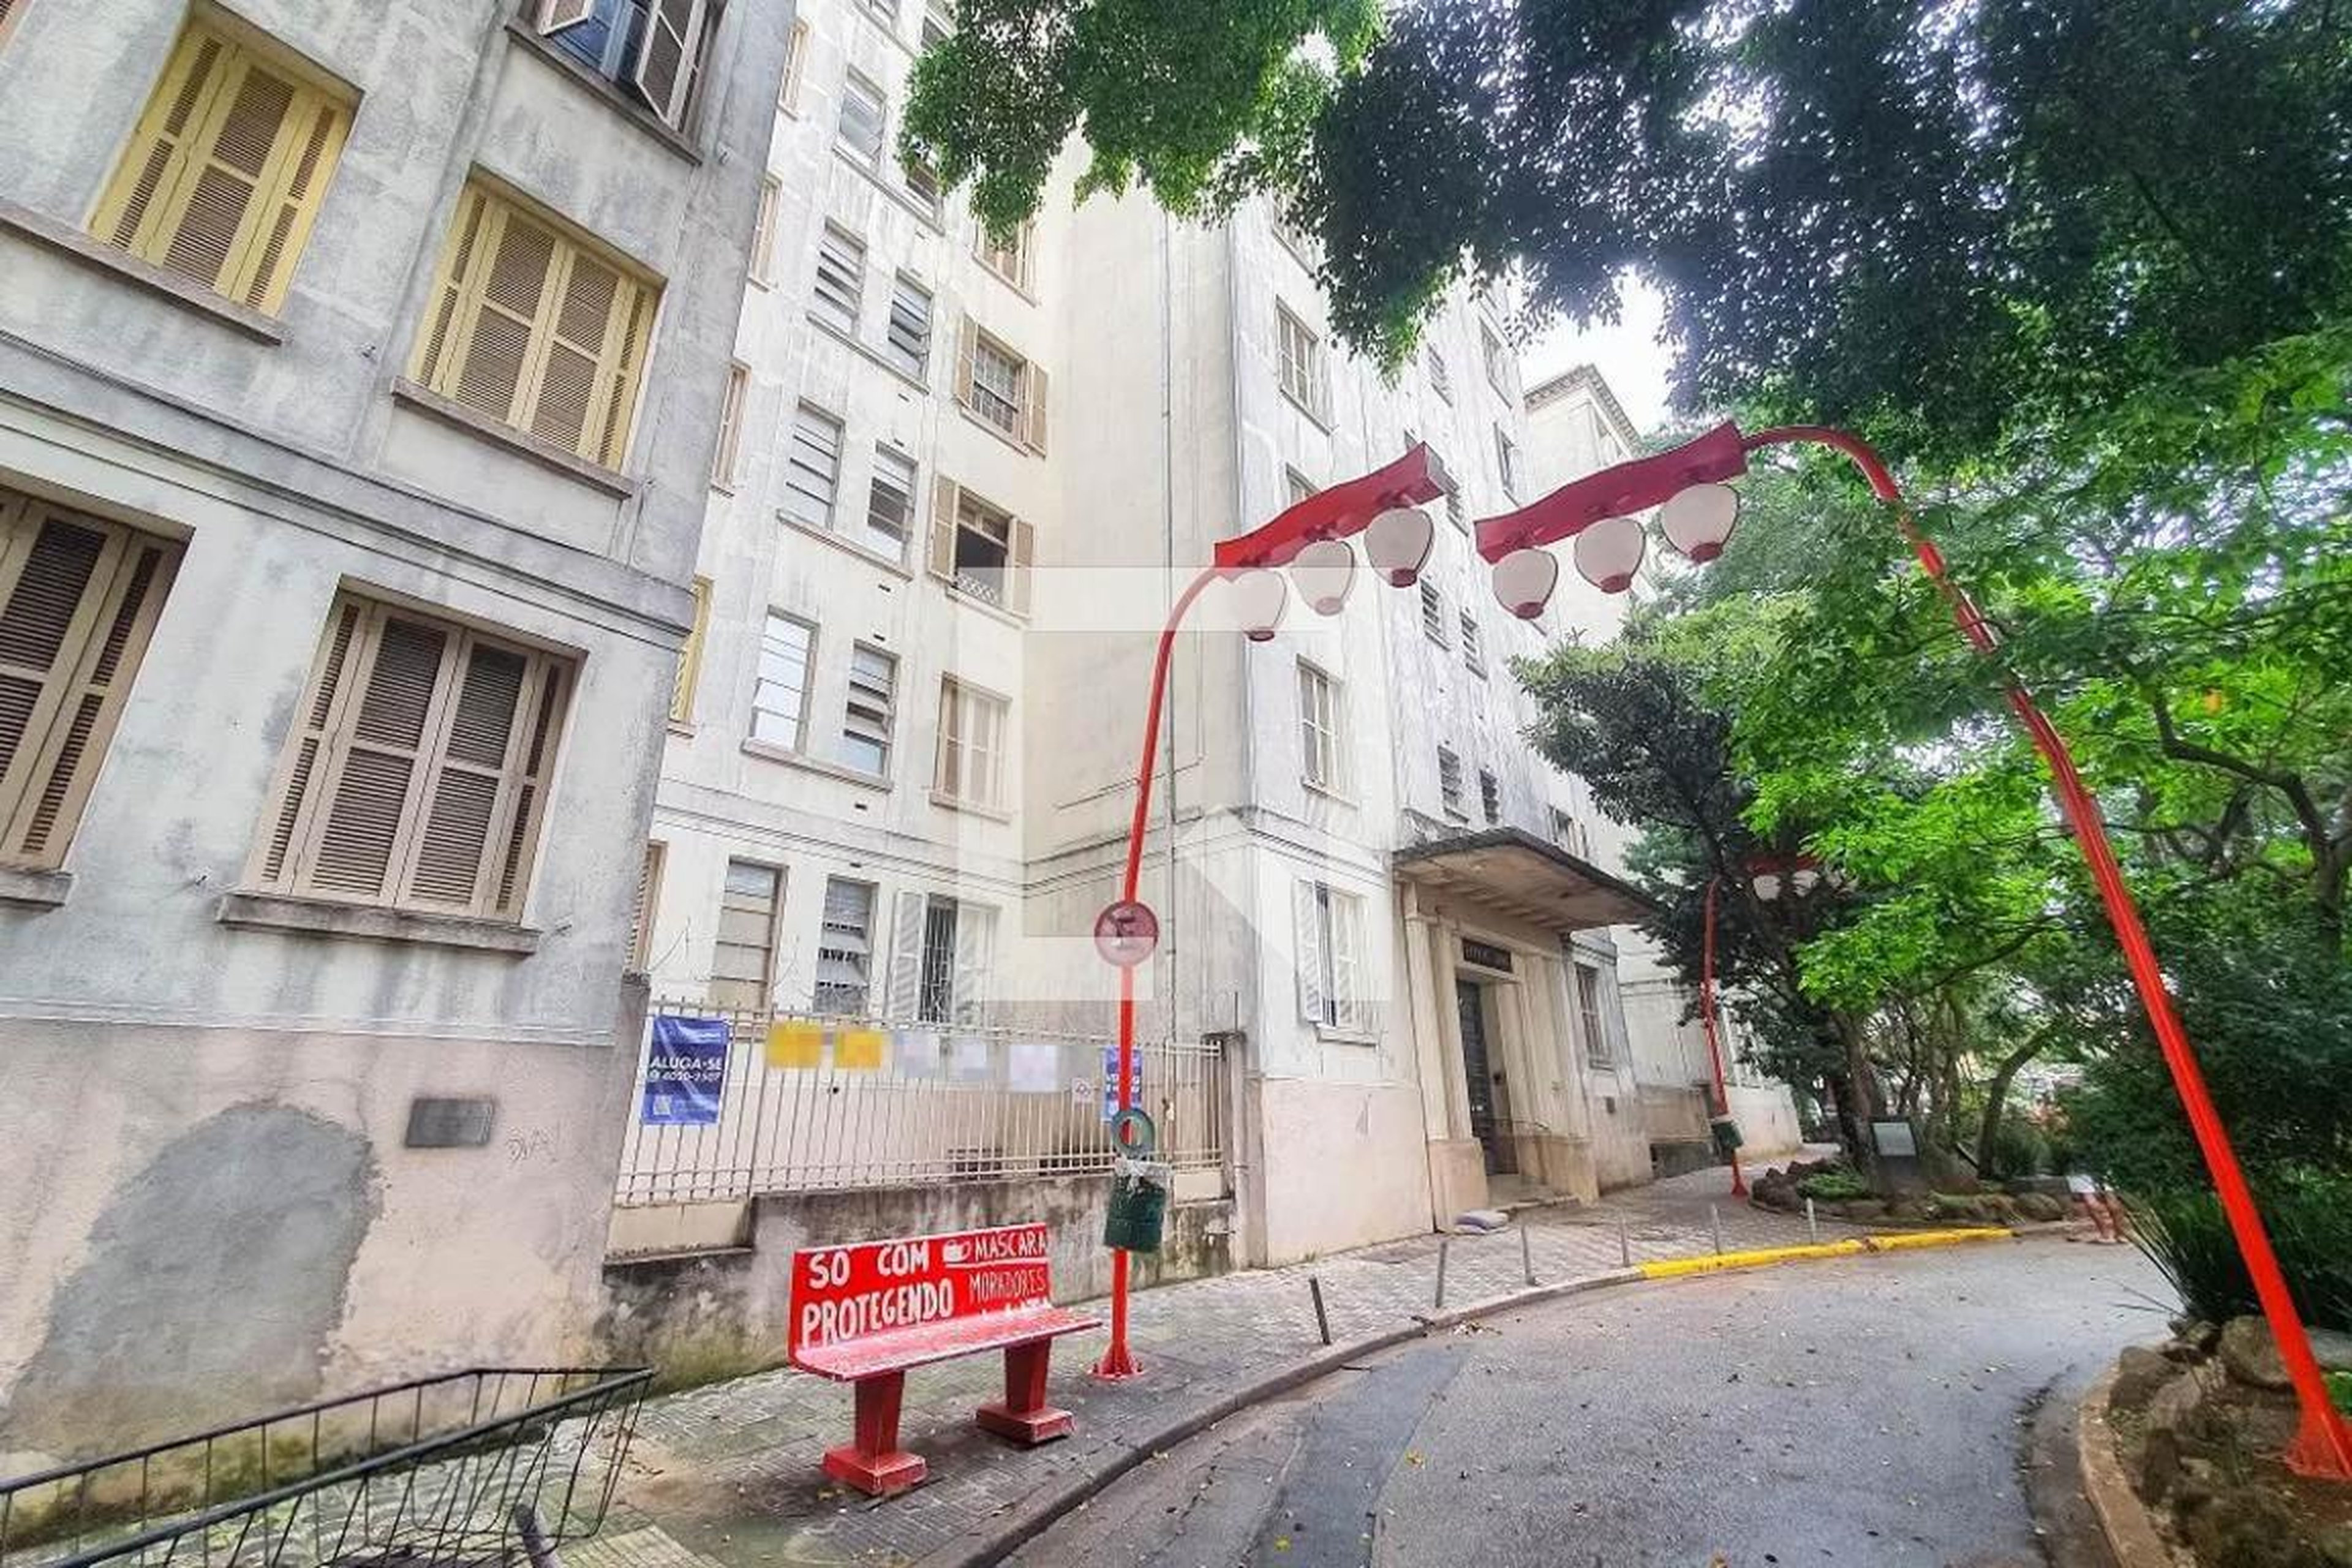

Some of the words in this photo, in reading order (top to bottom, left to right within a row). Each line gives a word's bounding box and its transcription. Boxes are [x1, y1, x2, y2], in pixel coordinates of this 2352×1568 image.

[650, 1056, 723, 1070] ALUGA-SE
[877, 1241, 930, 1276] COM
[975, 1231, 1047, 1261] MASCARA
[802, 1278, 954, 1348] PROTEGENDO
[968, 1267, 1047, 1305] MORADORES
